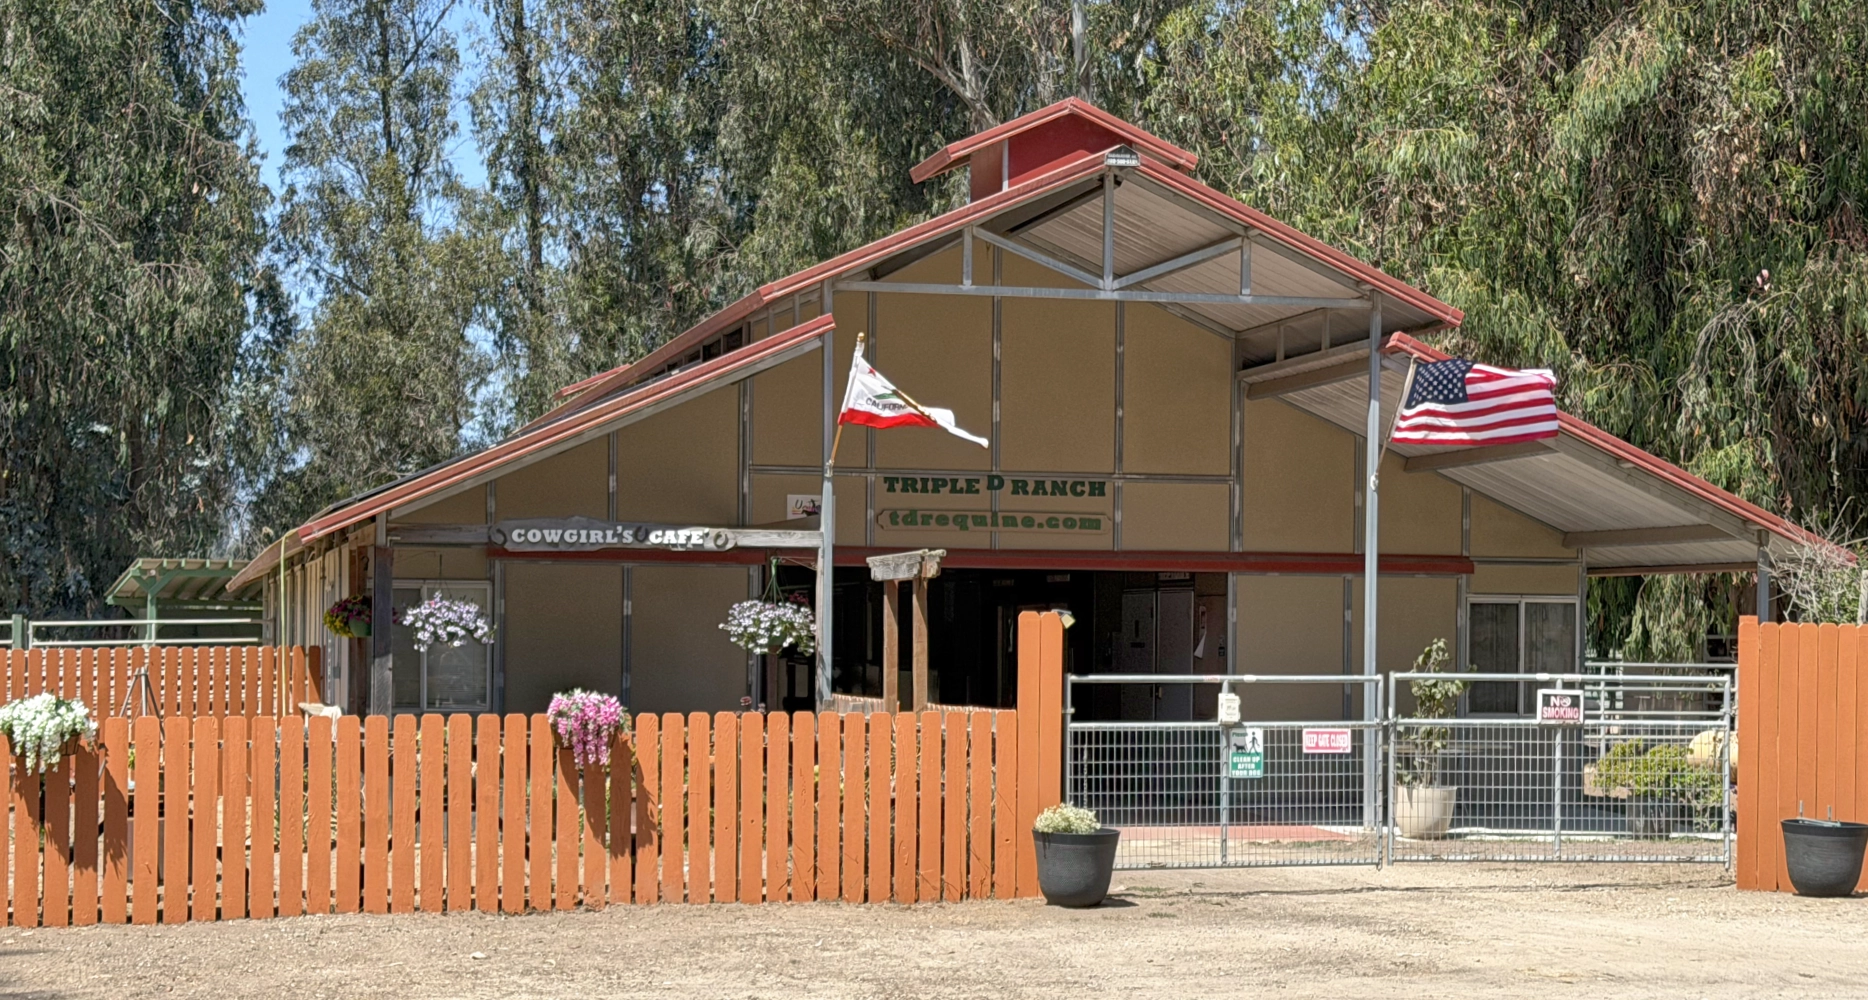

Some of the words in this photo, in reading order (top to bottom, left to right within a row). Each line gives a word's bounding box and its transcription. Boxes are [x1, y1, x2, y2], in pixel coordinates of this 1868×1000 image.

[883, 476, 980, 494] TRIPLE
[987, 474, 1005, 491] D
[1011, 479, 1107, 497] RANCH
[889, 509, 1102, 531] tdrequine.com
[511, 525, 634, 544] COWGIRL'S
[1550, 695, 1572, 707] NO
[1542, 706, 1579, 719] SMOKING
[1306, 733, 1318, 747] KEEP
[1318, 733, 1330, 747] GATE
[1330, 733, 1348, 748] CLOSED
